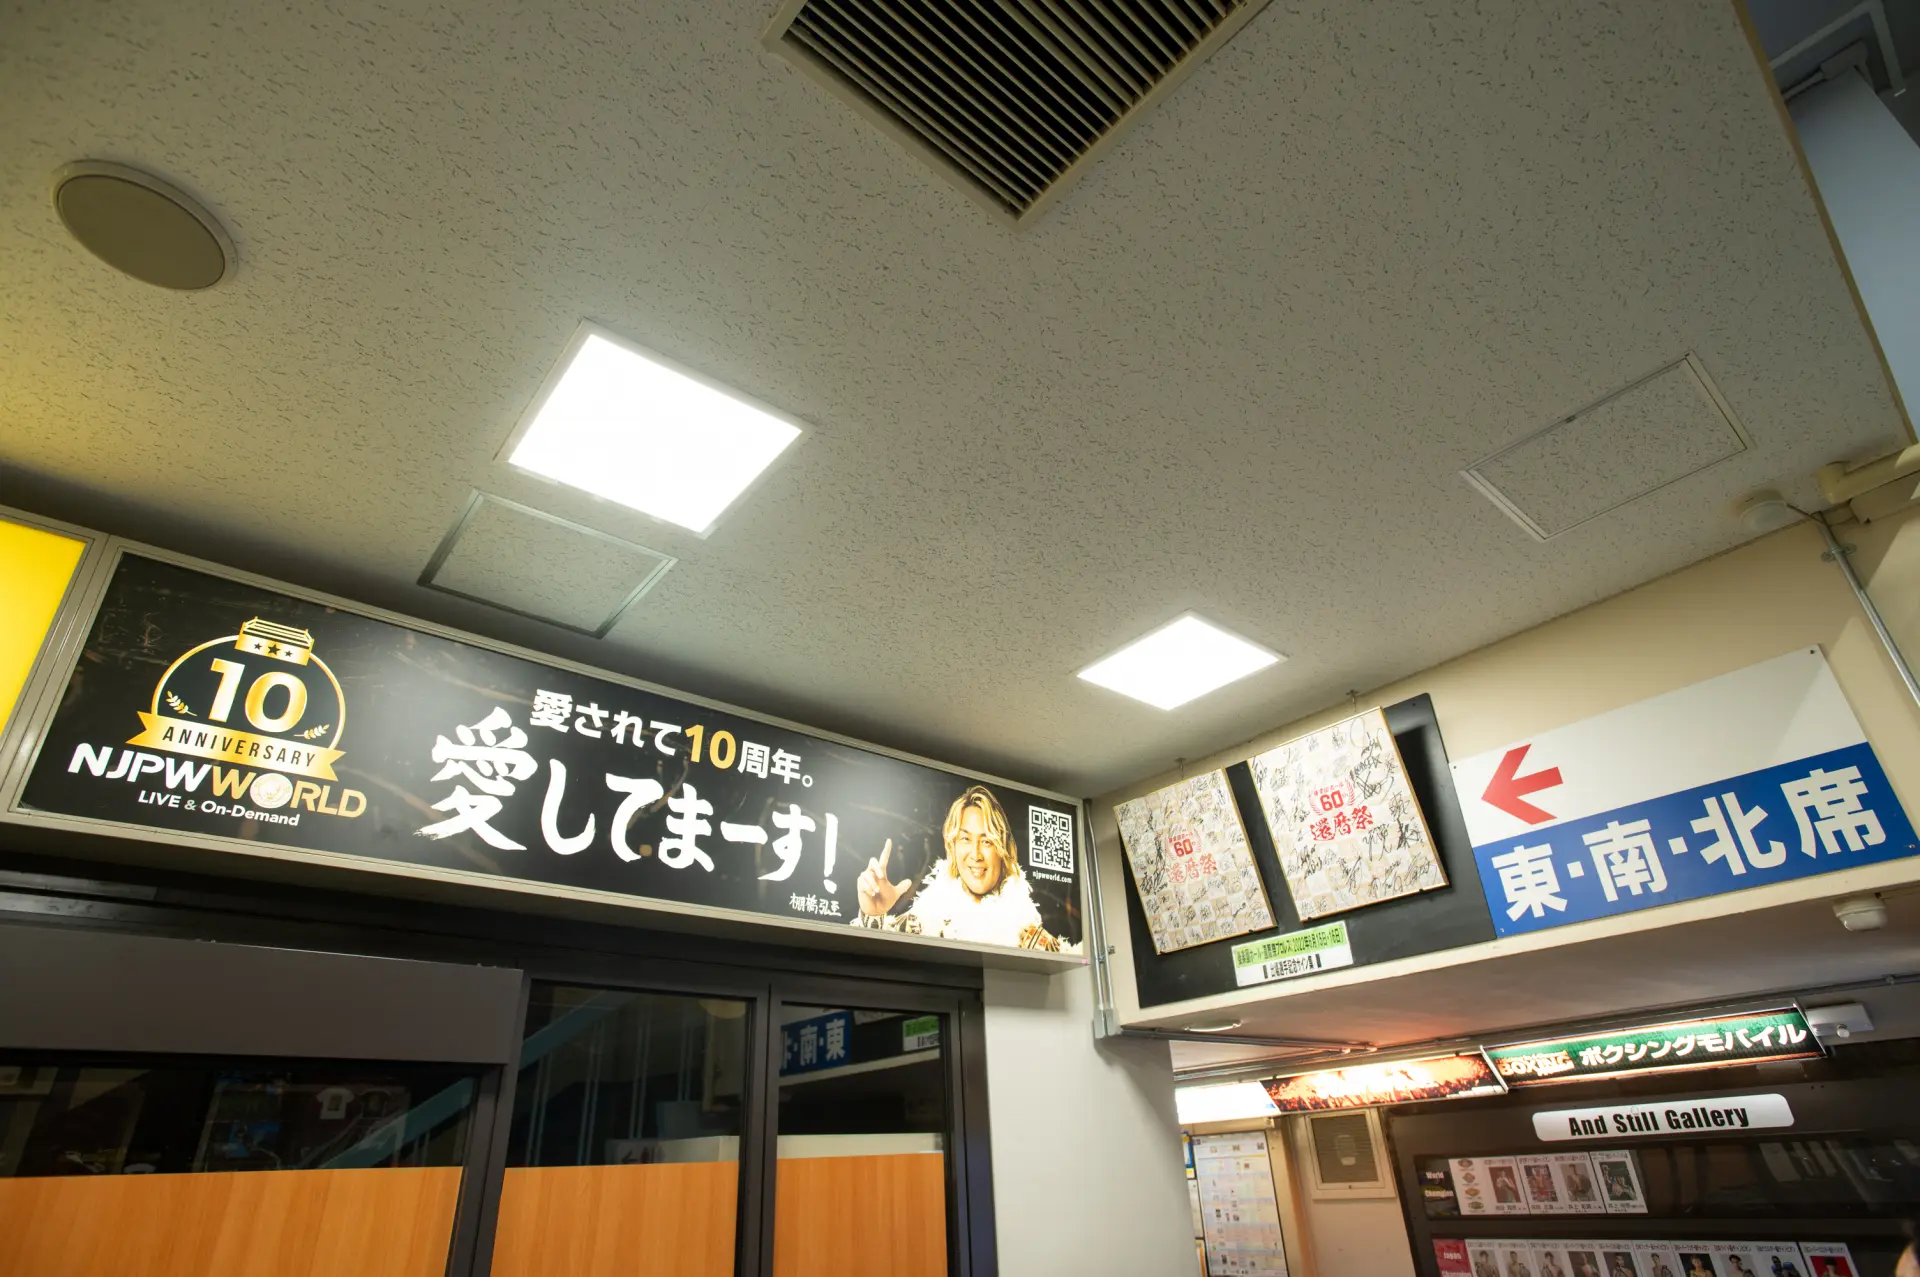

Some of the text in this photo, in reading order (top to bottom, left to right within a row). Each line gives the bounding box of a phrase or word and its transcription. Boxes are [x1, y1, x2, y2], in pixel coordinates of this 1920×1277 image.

[208, 658, 308, 733] 10
[162, 725, 317, 768] ANNIVERSARY
[529, 688, 813, 788] 愛されて10周年。
[138, 789, 301, 827] LIVE & On-Demand
[1309, 805, 1374, 841] 還暦祭
[1579, 1023, 1808, 1067] ボクシングモバイル
[1568, 1106, 1750, 1137] And Still Gallery
[1424, 1189, 1455, 1198] Champion
[1425, 1171, 1445, 1180] World
